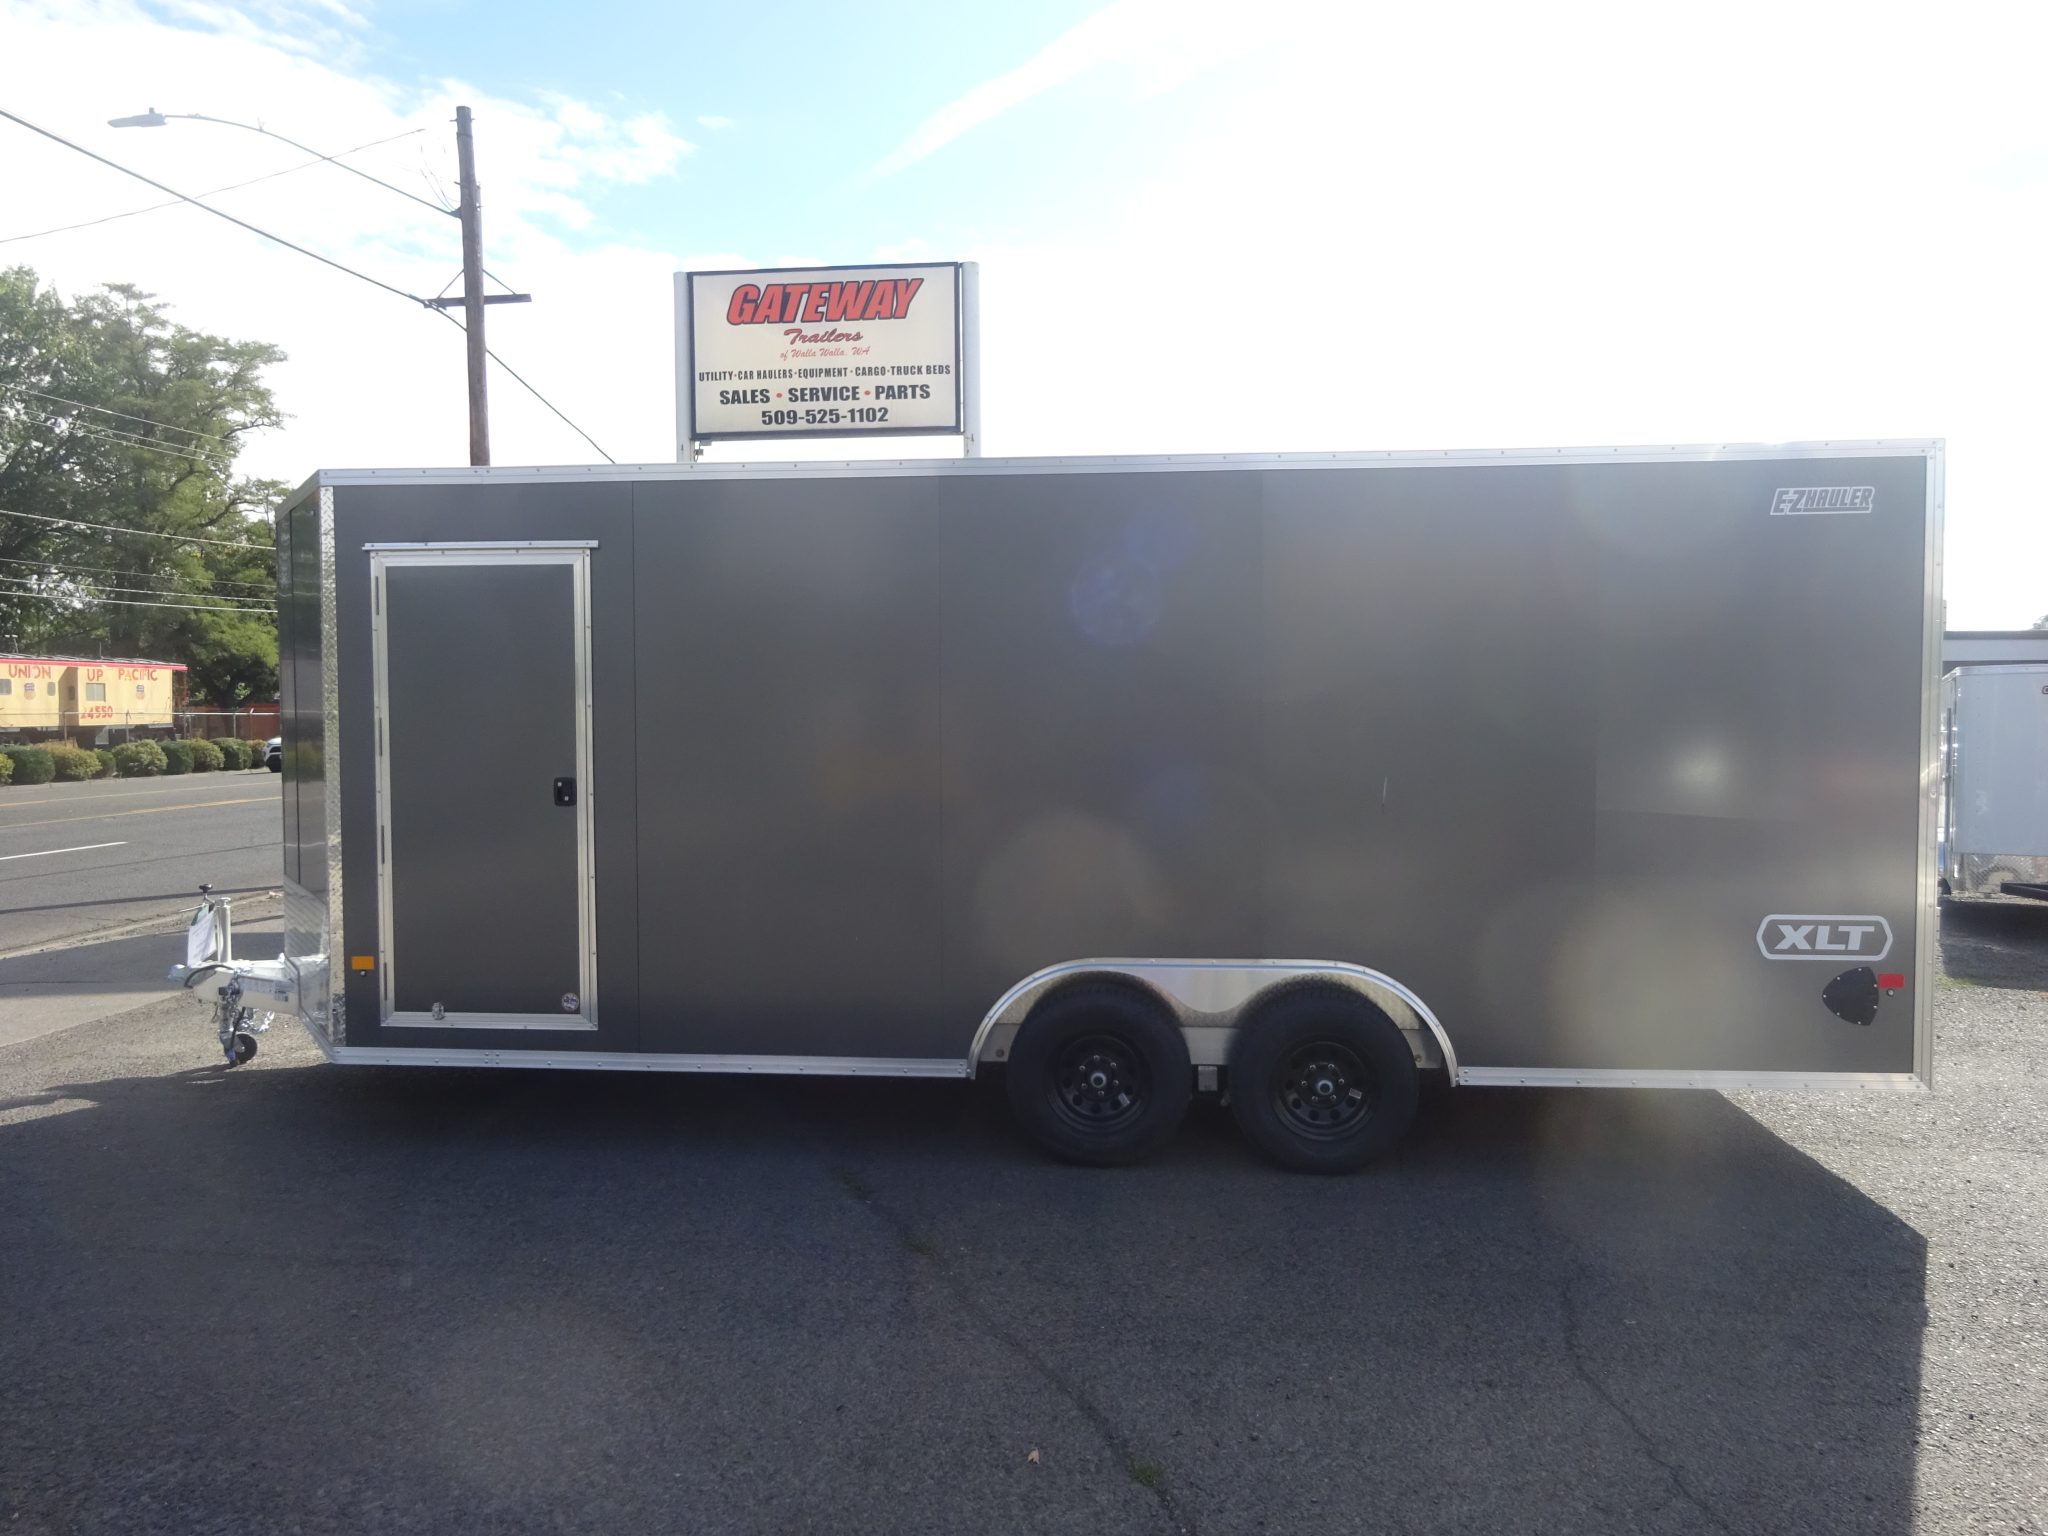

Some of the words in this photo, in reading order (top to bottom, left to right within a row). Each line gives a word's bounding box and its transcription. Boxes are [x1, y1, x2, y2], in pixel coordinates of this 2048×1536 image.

[726, 278, 924, 326] GATEWAY
[783, 328, 863, 345] Trailers
[779, 350, 789, 361] of
[791, 348, 817, 359] Walla
[851, 346, 871, 356] WA
[699, 371, 733, 382] UTILITY
[738, 370, 754, 381] CAR
[757, 369, 793, 380] HAULERS
[798, 367, 848, 379] EQUIPMENT
[855, 366, 886, 377] CARGO
[890, 365, 923, 376] TRUCK
[926, 364, 951, 375] BEDS
[719, 388, 771, 405] SALES
[788, 386, 860, 403] SERVICE
[875, 384, 930, 401] PARTS
[761, 406, 889, 426] 509-525-1102
[8, 664, 52, 679] UNION
[87, 668, 104, 682] UP
[118, 668, 158, 681] PACIFIC
[1773, 924, 1875, 951] XLT
